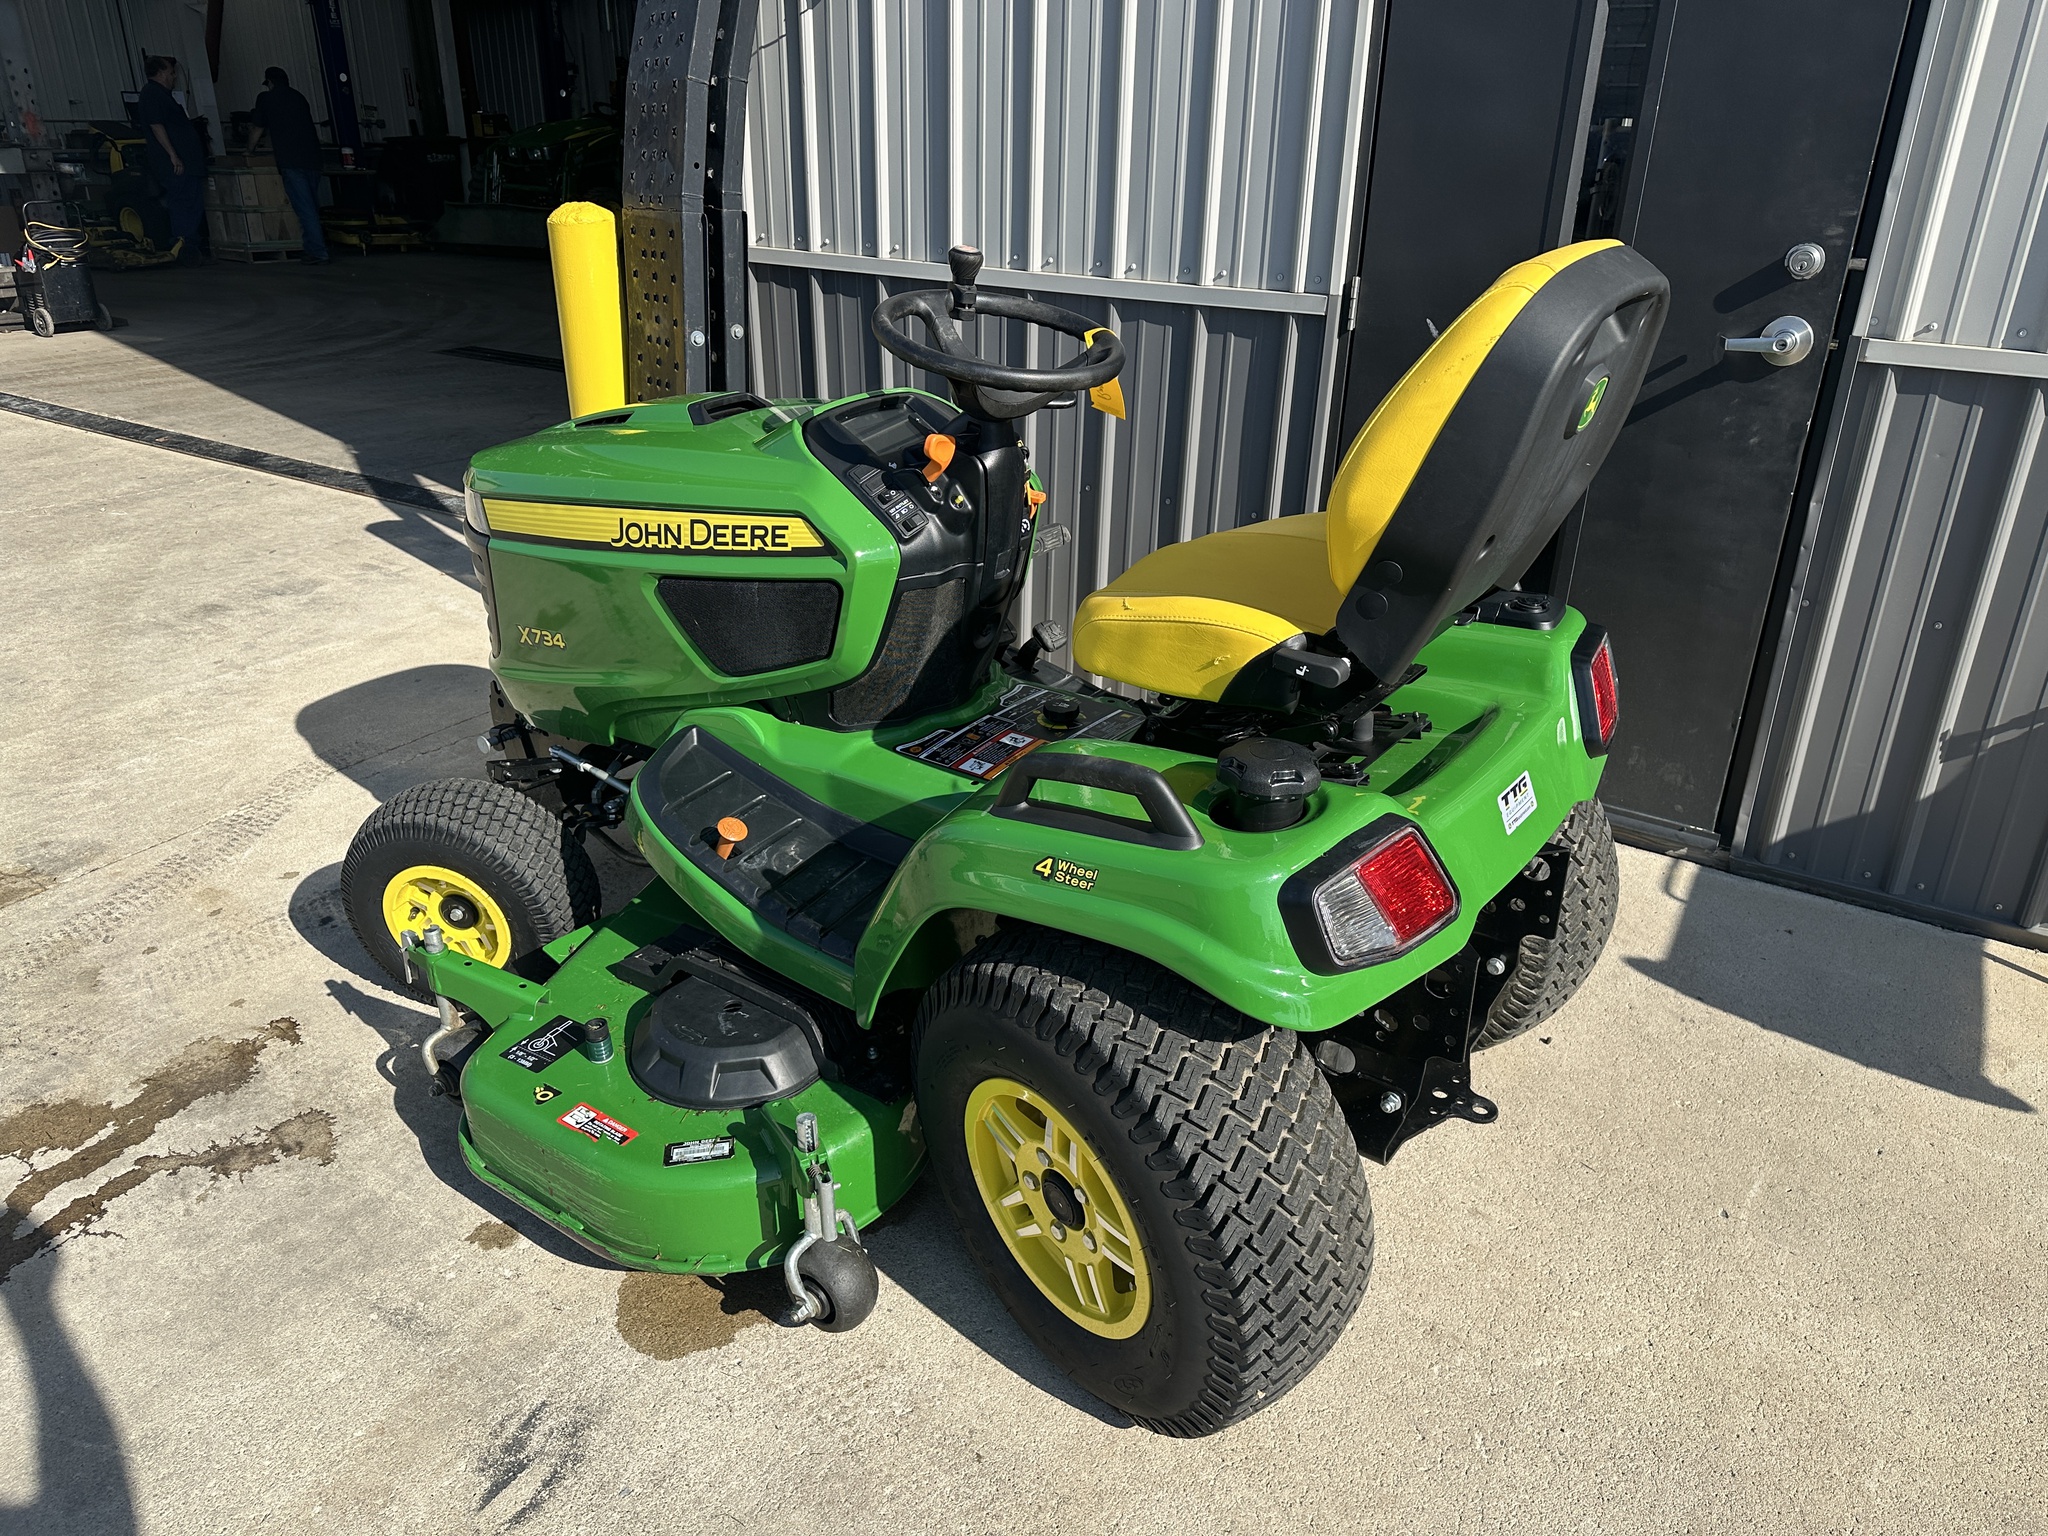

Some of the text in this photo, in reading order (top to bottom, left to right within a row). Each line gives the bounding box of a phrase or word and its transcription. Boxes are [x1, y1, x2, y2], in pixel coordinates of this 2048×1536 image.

[611, 517, 789, 548] JOHN DEERE
[517, 624, 566, 649] X734
[1501, 775, 1527, 807] TTG
[1034, 857, 1098, 881] 4 Wheel
[1054, 871, 1095, 891] Steer
[608, 1120, 628, 1133] DANGER
